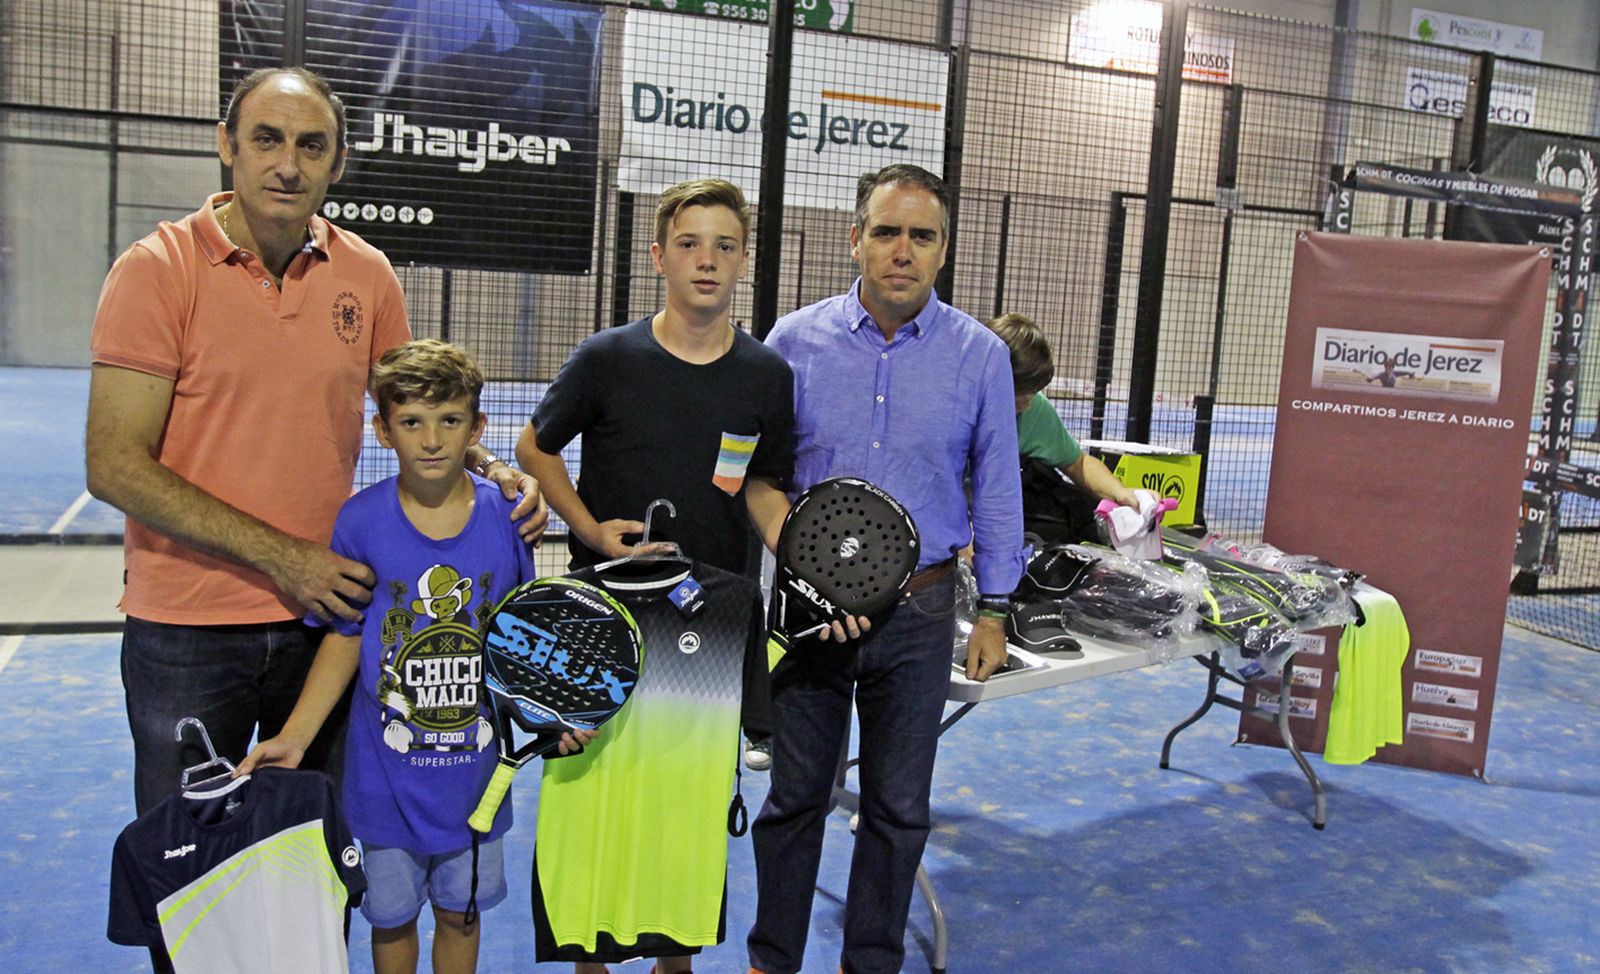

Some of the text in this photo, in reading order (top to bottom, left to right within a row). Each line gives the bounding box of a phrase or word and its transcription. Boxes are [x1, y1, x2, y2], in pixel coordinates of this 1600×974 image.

[631, 82, 910, 154] Diario e Jerez
[1395, 172, 1443, 189] COCINAS
[1445, 179, 1452, 189] Y
[1490, 183, 1504, 195] DE
[1505, 186, 1539, 199] HOGAR
[1324, 341, 1483, 375] Diario de Jerez
[1291, 399, 1515, 430] COMPARTIMOS JEREZ A DIARIO
[1142, 471, 1165, 493] SOY
[565, 589, 614, 616] ORIGEN
[405, 654, 483, 687] CHICO
[415, 684, 478, 709] MALO
[424, 731, 465, 744] SO GOOD
[410, 754, 471, 768] SUPERSTAR
